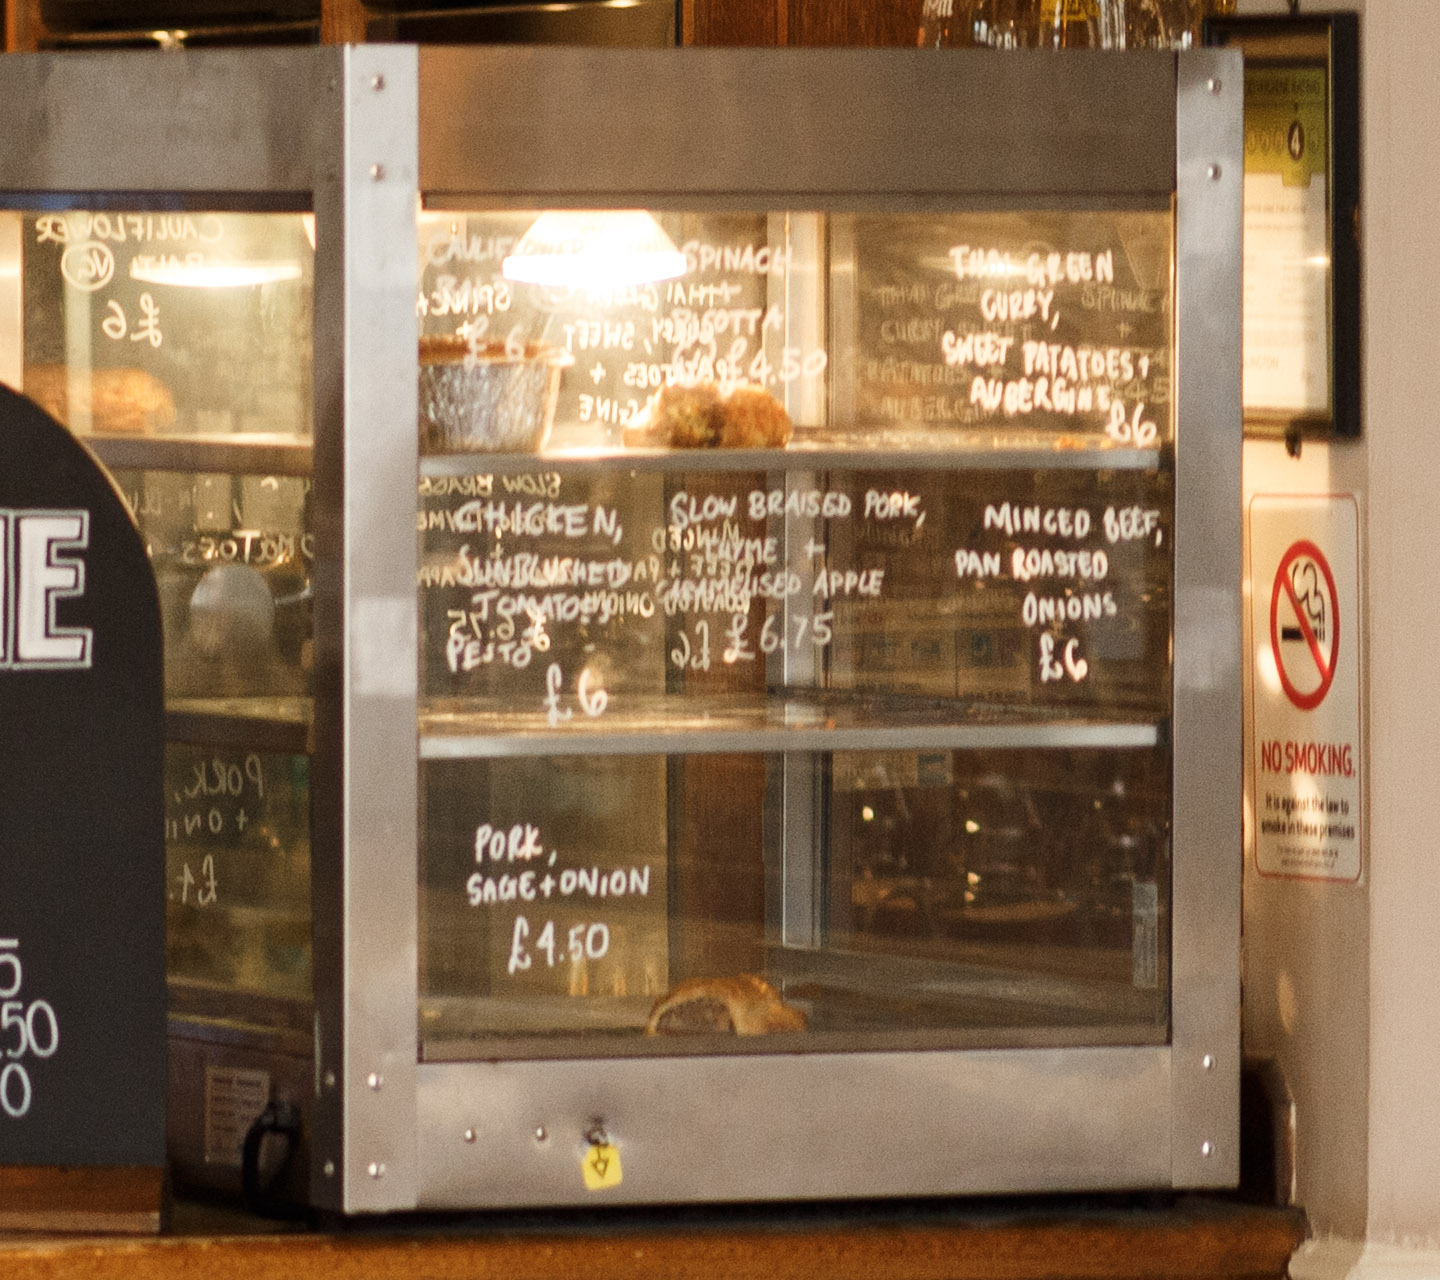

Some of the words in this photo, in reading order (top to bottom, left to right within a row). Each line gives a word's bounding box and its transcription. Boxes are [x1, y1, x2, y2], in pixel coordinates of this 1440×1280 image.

[1025, 249, 1115, 288] GREEN
[941, 330, 1014, 367] SWEET
[970, 375, 1112, 417] AUBERGINE
[454, 499, 623, 546] CHICKEN,
[670, 489, 738, 531] SLOW
[748, 489, 853, 520] BRAISED
[983, 501, 1091, 539] MINCED
[812, 567, 885, 599] APPLE
[954, 548, 1001, 578] PAN
[1011, 546, 1110, 582] ROASTED
[1022, 590, 1118, 627] ONIONS
[1039, 631, 1089, 683] £6
[1261, 740, 1282, 774] NO
[1326, 796, 1339, 815] law
[474, 823, 558, 867] PORK,
[1261, 818, 1286, 835] smoke
[1319, 823, 1356, 842] premises
[507, 915, 610, 975] £4.50
